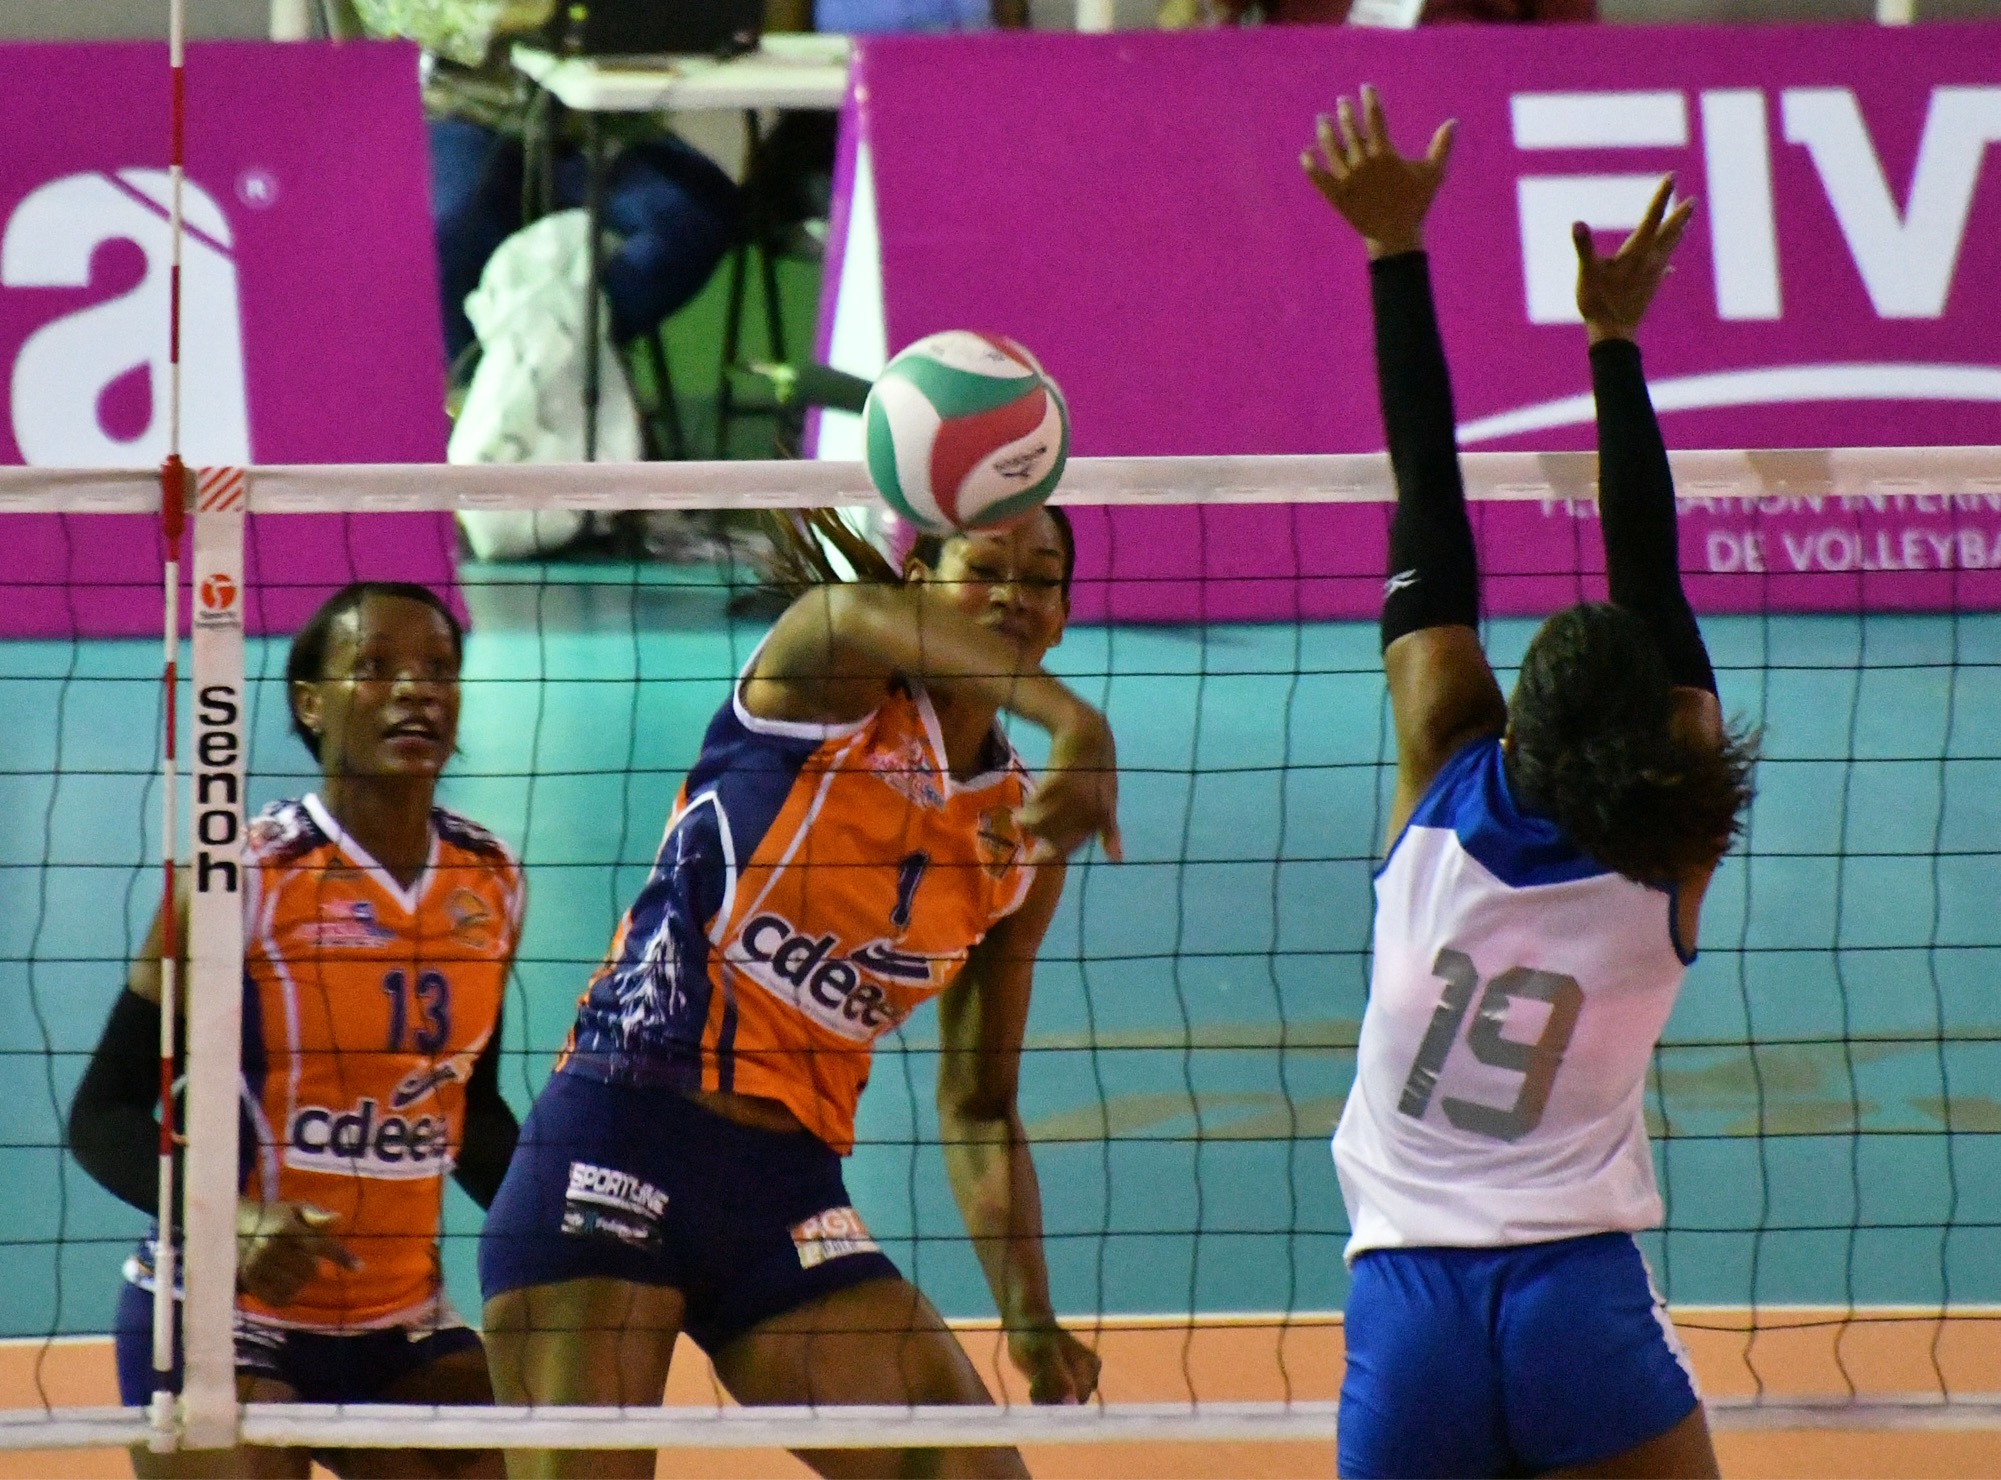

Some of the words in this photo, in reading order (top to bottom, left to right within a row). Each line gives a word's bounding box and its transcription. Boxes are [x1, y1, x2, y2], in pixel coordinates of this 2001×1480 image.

[1511, 87, 2001, 324] FIV
[1707, 530, 1766, 572] DE
[1784, 527, 2001, 571] VOLLEYB
[198, 686, 237, 892] Senoh
[891, 853, 928, 926] 1
[383, 969, 450, 1053] 13
[1398, 948, 1585, 1144] 19
